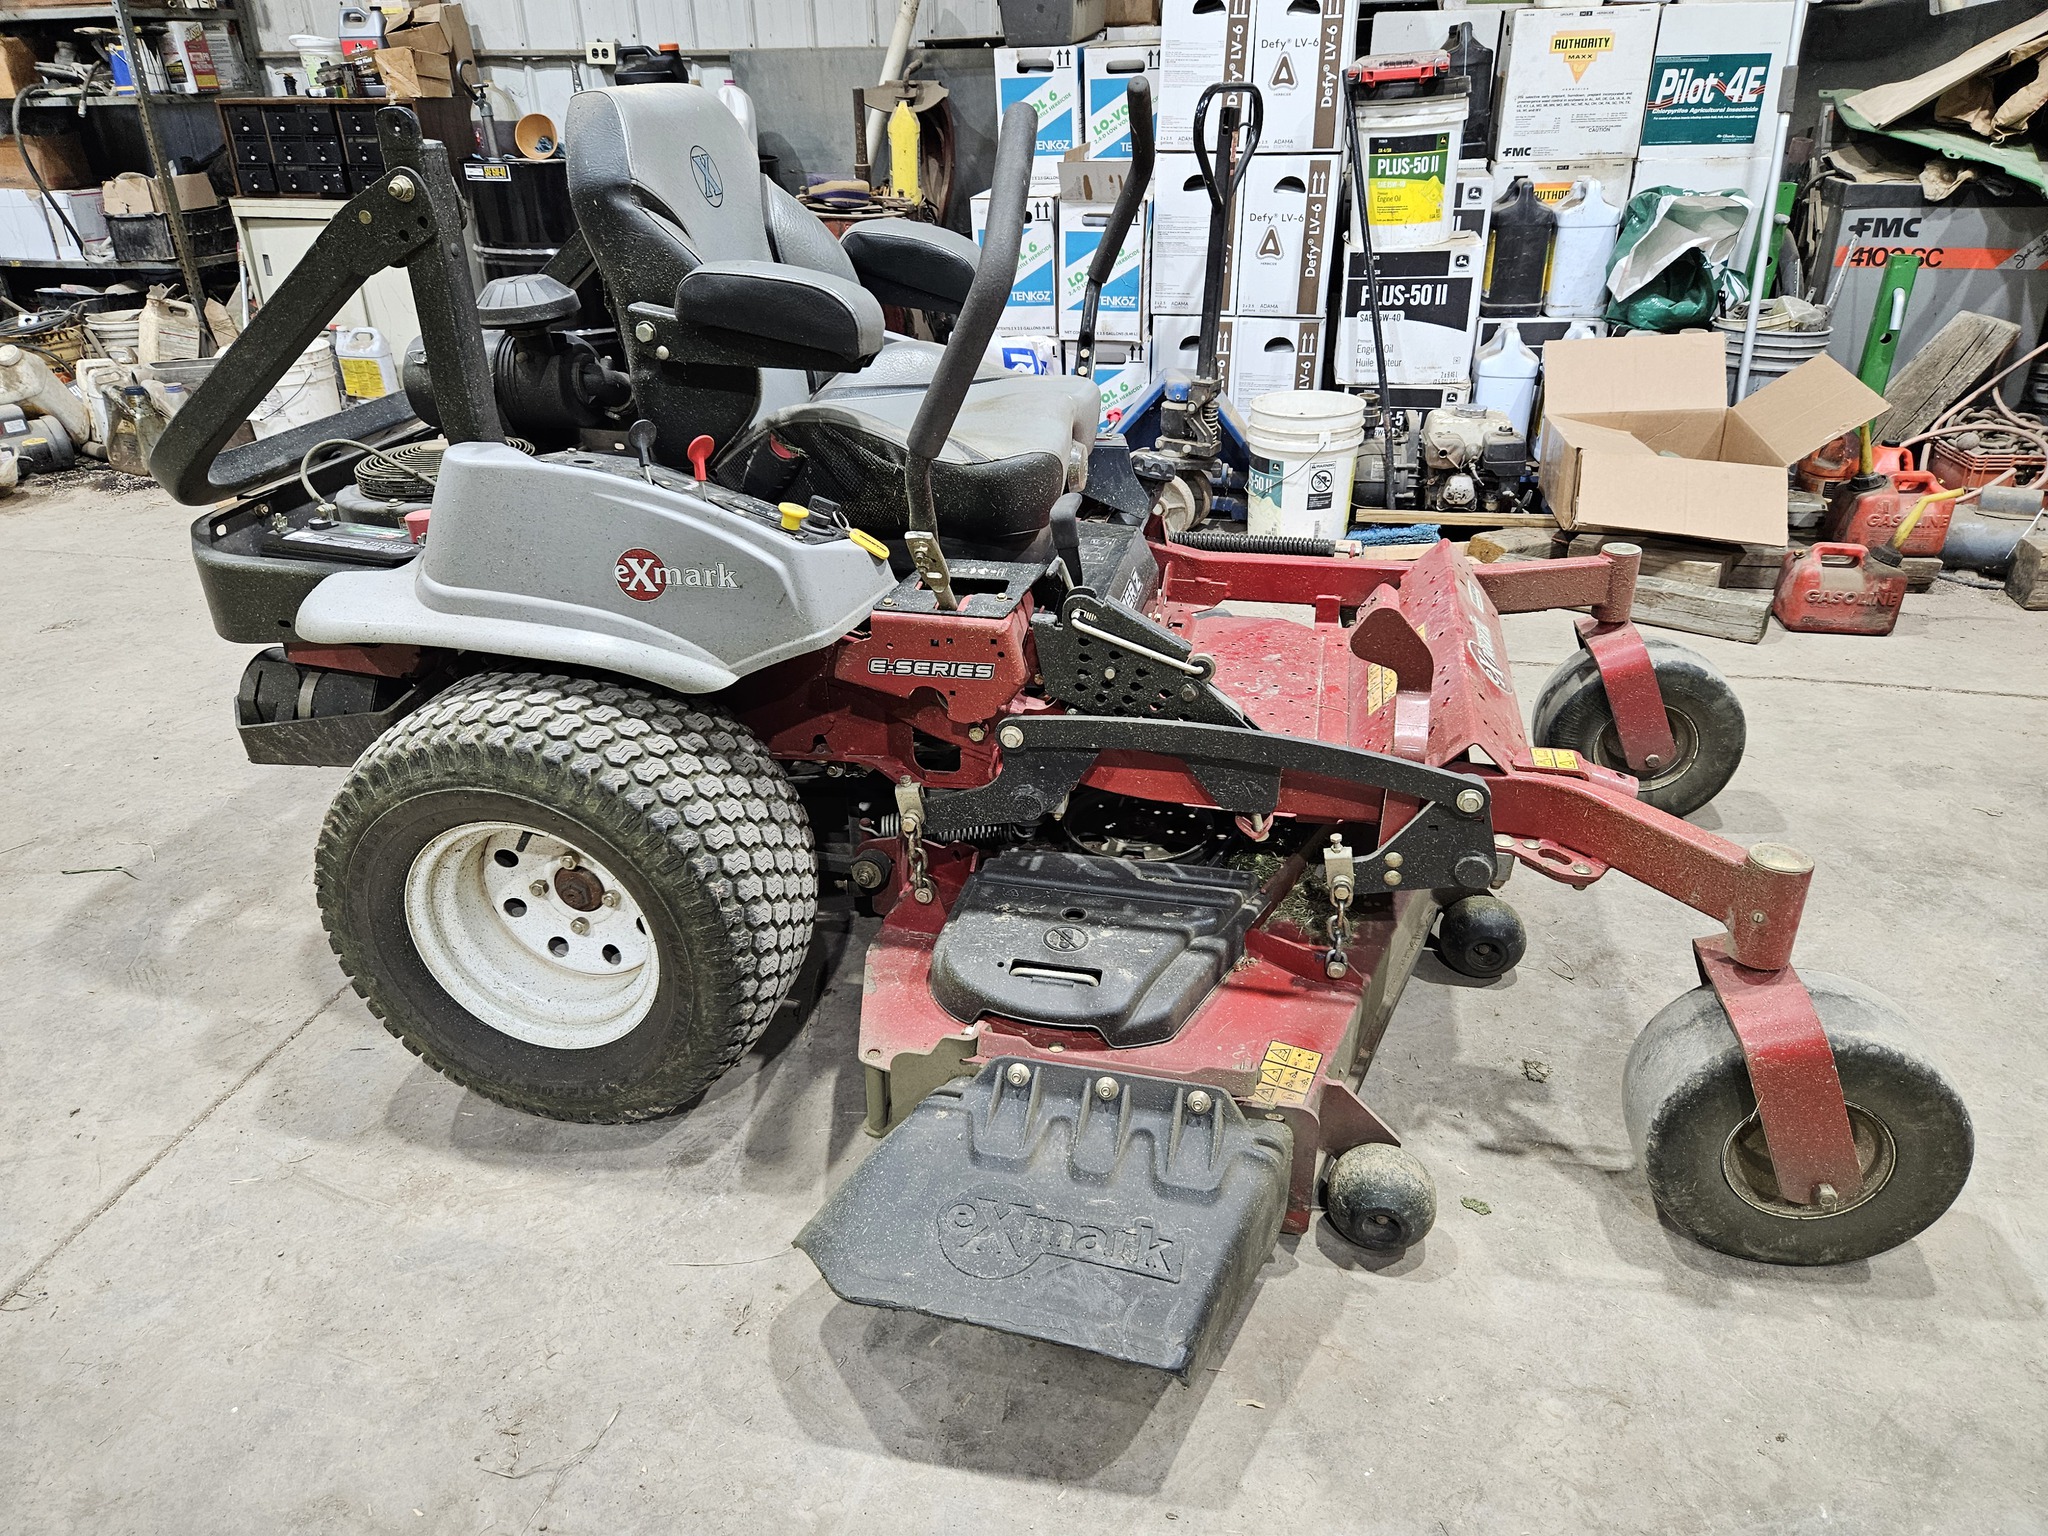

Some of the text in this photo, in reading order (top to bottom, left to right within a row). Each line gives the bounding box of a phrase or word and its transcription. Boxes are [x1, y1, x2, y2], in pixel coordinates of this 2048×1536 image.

[1295, 38, 1319, 48] LV-6
[1554, 37, 1610, 50] AUTHORITY
[1724, 67, 1766, 103] 4E
[1049, 90, 1058, 101] 6
[1093, 105, 1129, 135] LO-VO
[1502, 147, 1531, 157] FMC
[1377, 156, 1429, 176] PLUS-50
[1377, 195, 1393, 203] Engine
[1281, 213, 1304, 222] LV-6
[1849, 218, 1922, 238] FMC
[1029, 242, 1038, 252] 6
[1357, 344, 1394, 355] Engin Oil
[1355, 358, 1402, 367] Huile oteur
[1119, 384, 1143, 401] HERBICIDE
[1120, 382, 1129, 392] 6
[1805, 589, 1899, 608] GASOLINE
[868, 658, 995, 680] E-SERIES
